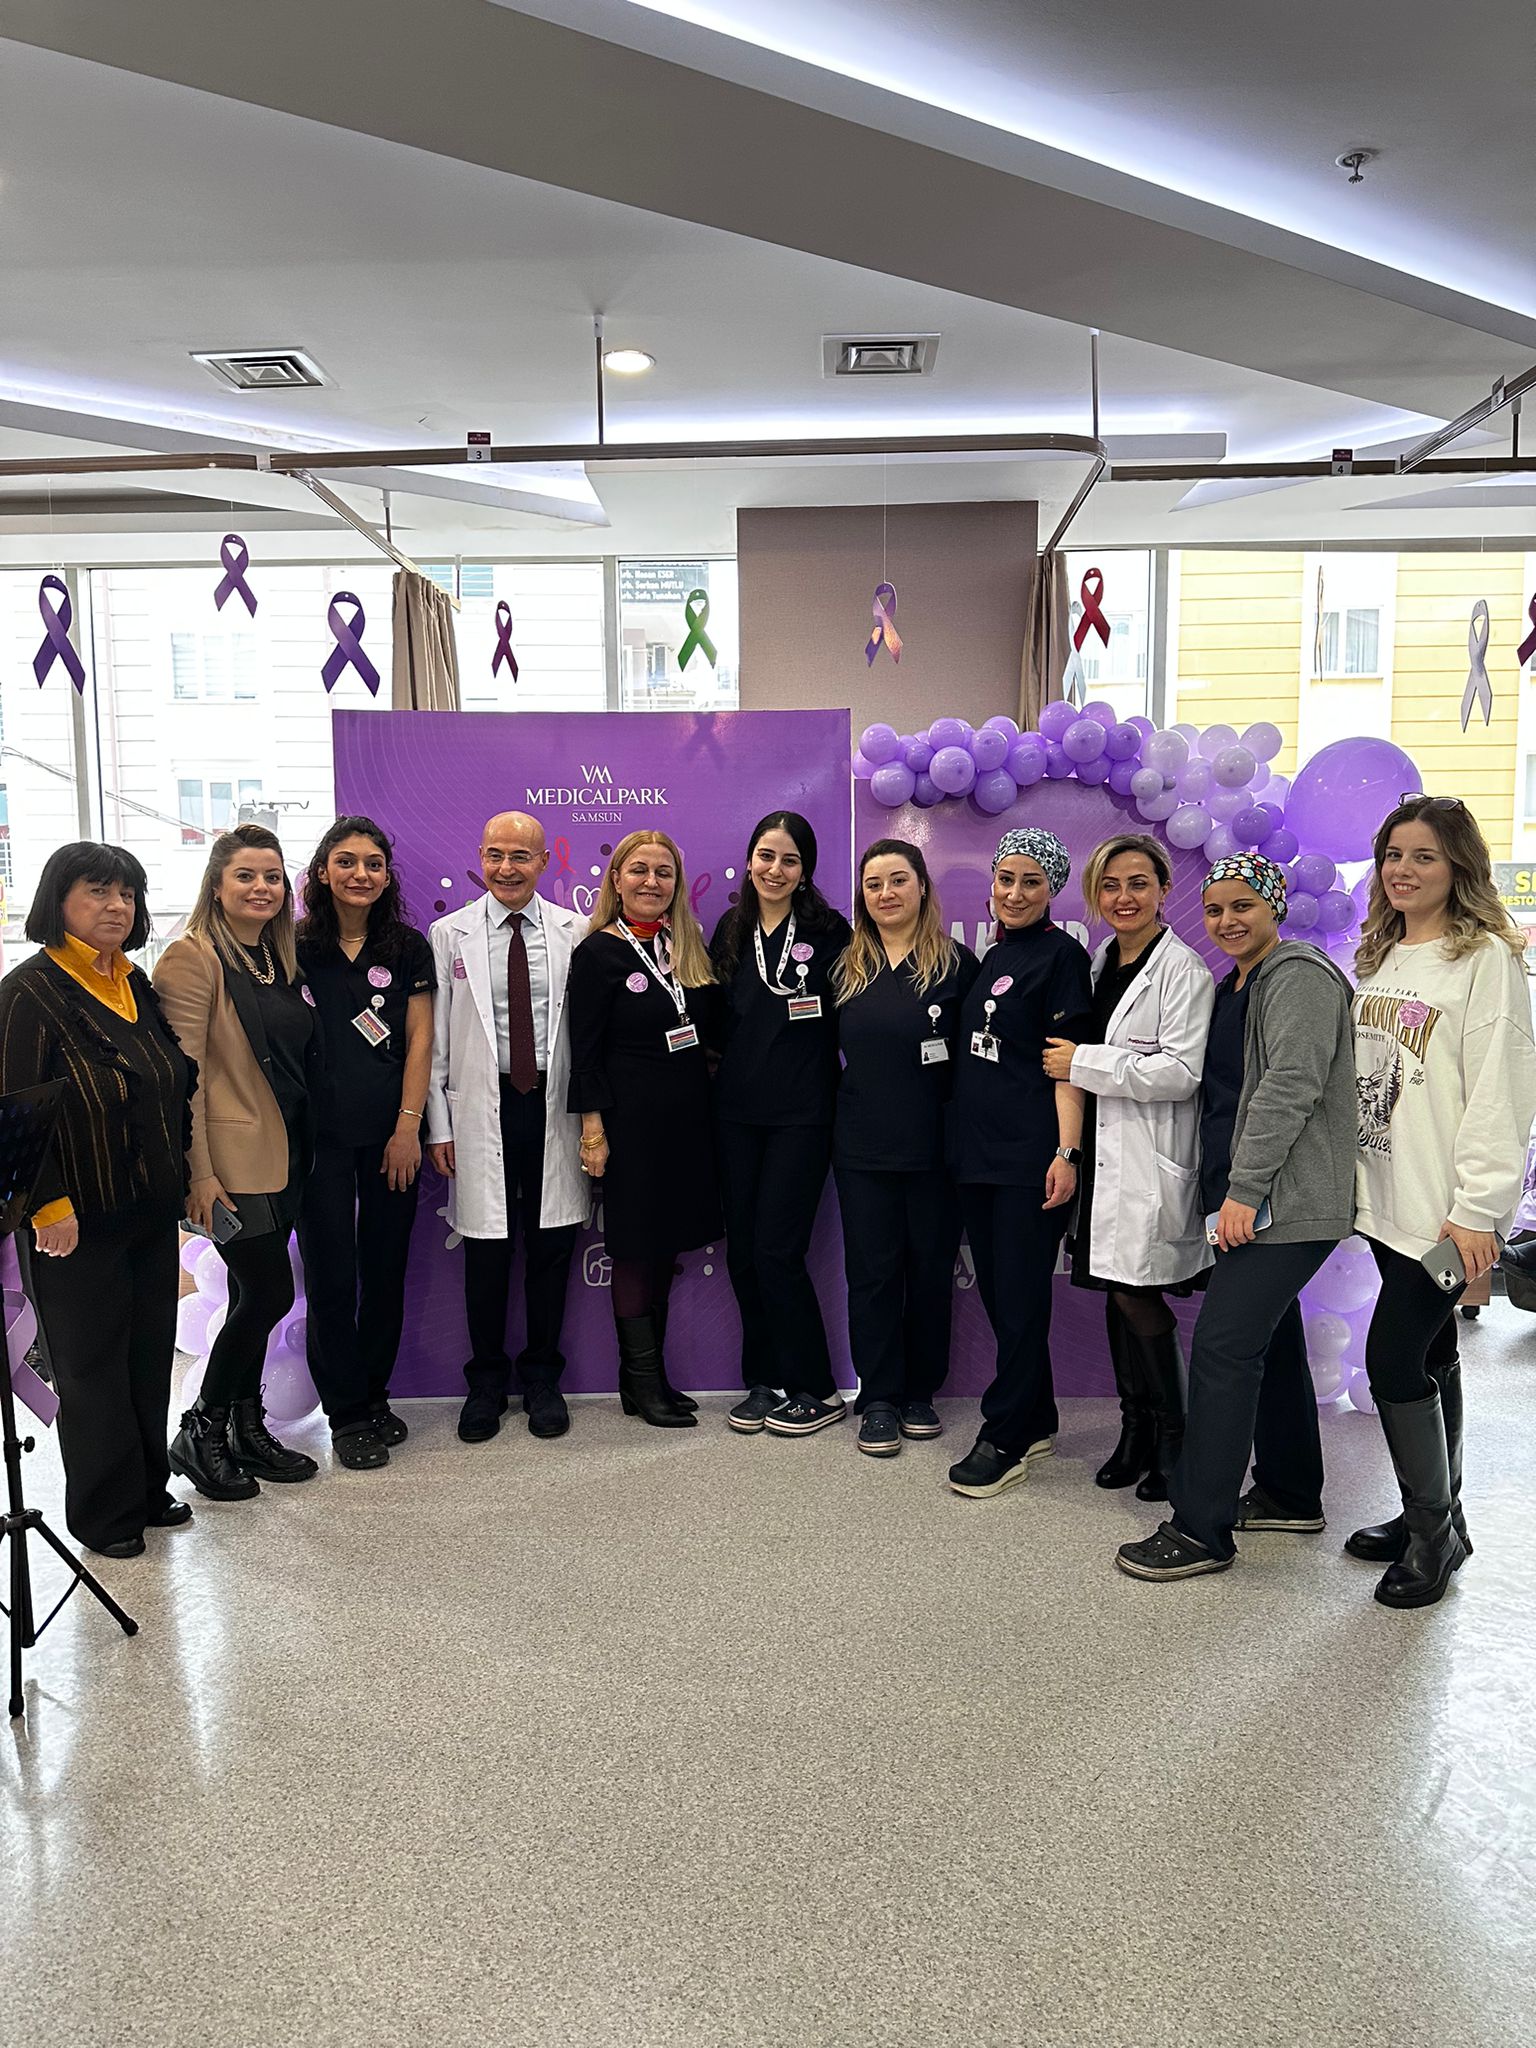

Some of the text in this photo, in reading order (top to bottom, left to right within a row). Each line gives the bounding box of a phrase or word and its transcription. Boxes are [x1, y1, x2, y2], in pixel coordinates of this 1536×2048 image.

[476, 450, 482, 460] 3
[1337, 465, 1344, 474] 4
[525, 788, 669, 805] MEDICALPARK
[571, 811, 623, 823] SAMSUN
[1515, 870, 1536, 893] S
[1500, 895, 1536, 906] RESTO
[1356, 985, 1421, 999] TIONAL PARK
[1354, 1030, 1386, 1043] OSEMITE
